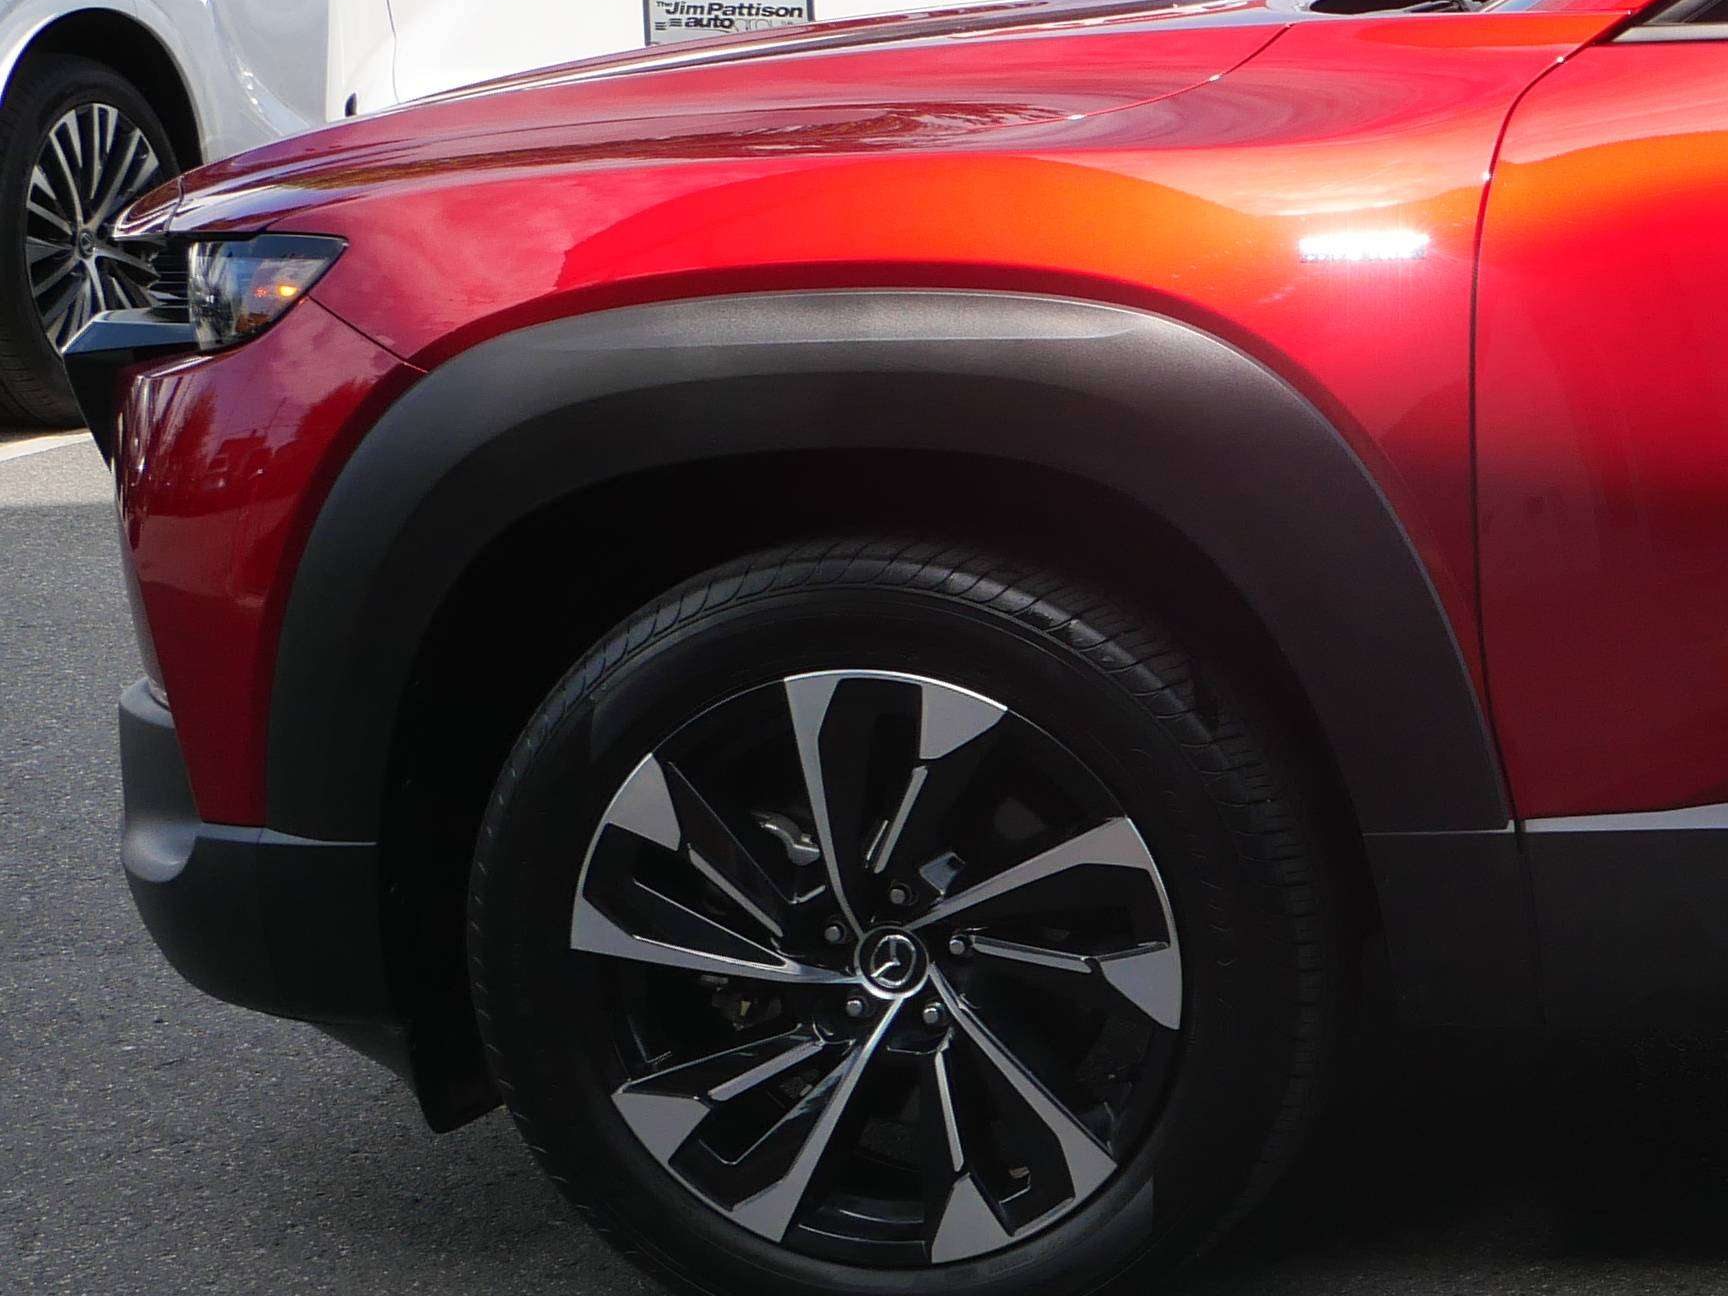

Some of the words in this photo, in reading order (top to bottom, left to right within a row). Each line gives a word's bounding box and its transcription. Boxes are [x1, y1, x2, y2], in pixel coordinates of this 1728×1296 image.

[665, 1, 704, 15] Jim
[708, 2, 803, 18] Pattison
[684, 16, 735, 29] auto
